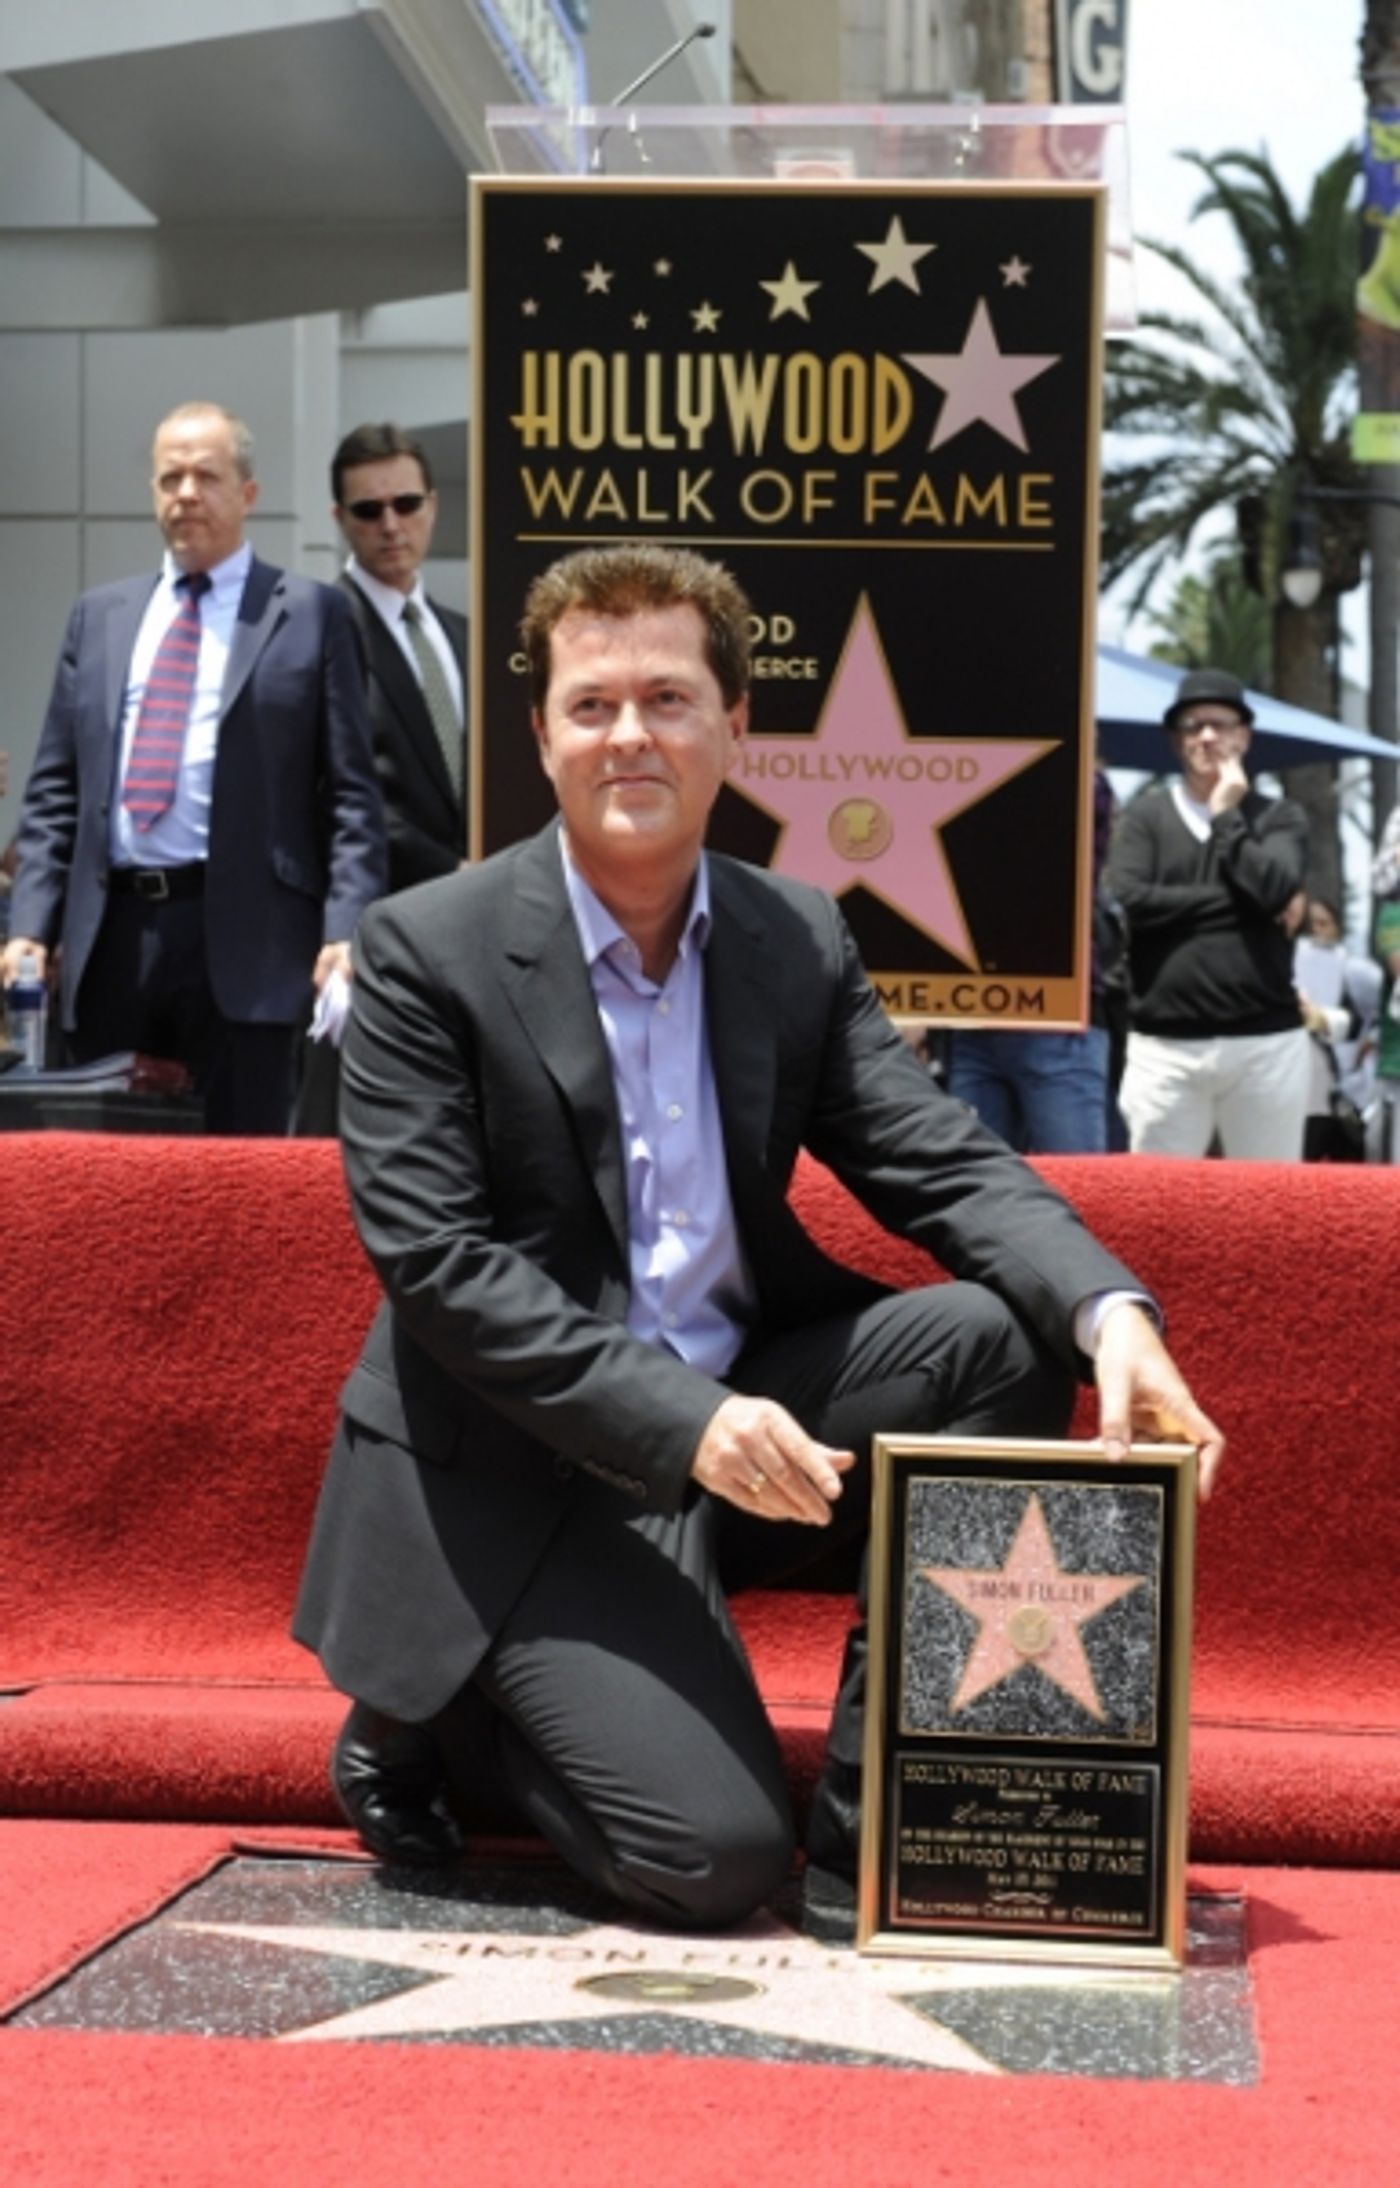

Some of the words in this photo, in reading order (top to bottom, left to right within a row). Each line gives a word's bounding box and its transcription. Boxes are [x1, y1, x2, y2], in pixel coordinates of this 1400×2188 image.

[1071, 2, 1123, 94] G
[510, 350, 914, 457] HOLLYWOOD
[520, 467, 715, 523] WALK
[740, 470, 837, 524] OF
[864, 472, 1054, 527] FAME
[742, 752, 980, 783] HOLLYWOOD
[875, 982, 1046, 1014] ME.COM
[968, 1579, 1022, 1600] SIMON
[1028, 1580, 1095, 1602] FULLER
[903, 1764, 1011, 1788] HOLLYWOOD
[1013, 1768, 1067, 1790] WALK
[1071, 1771, 1094, 1792] OF
[1097, 1772, 1148, 1795] FAME
[901, 1844, 1008, 1868] HOLLYWOOD
[1011, 1848, 1065, 1871] WALK
[1068, 1852, 1091, 1872] OF
[1094, 1853, 1145, 1876] FAME
